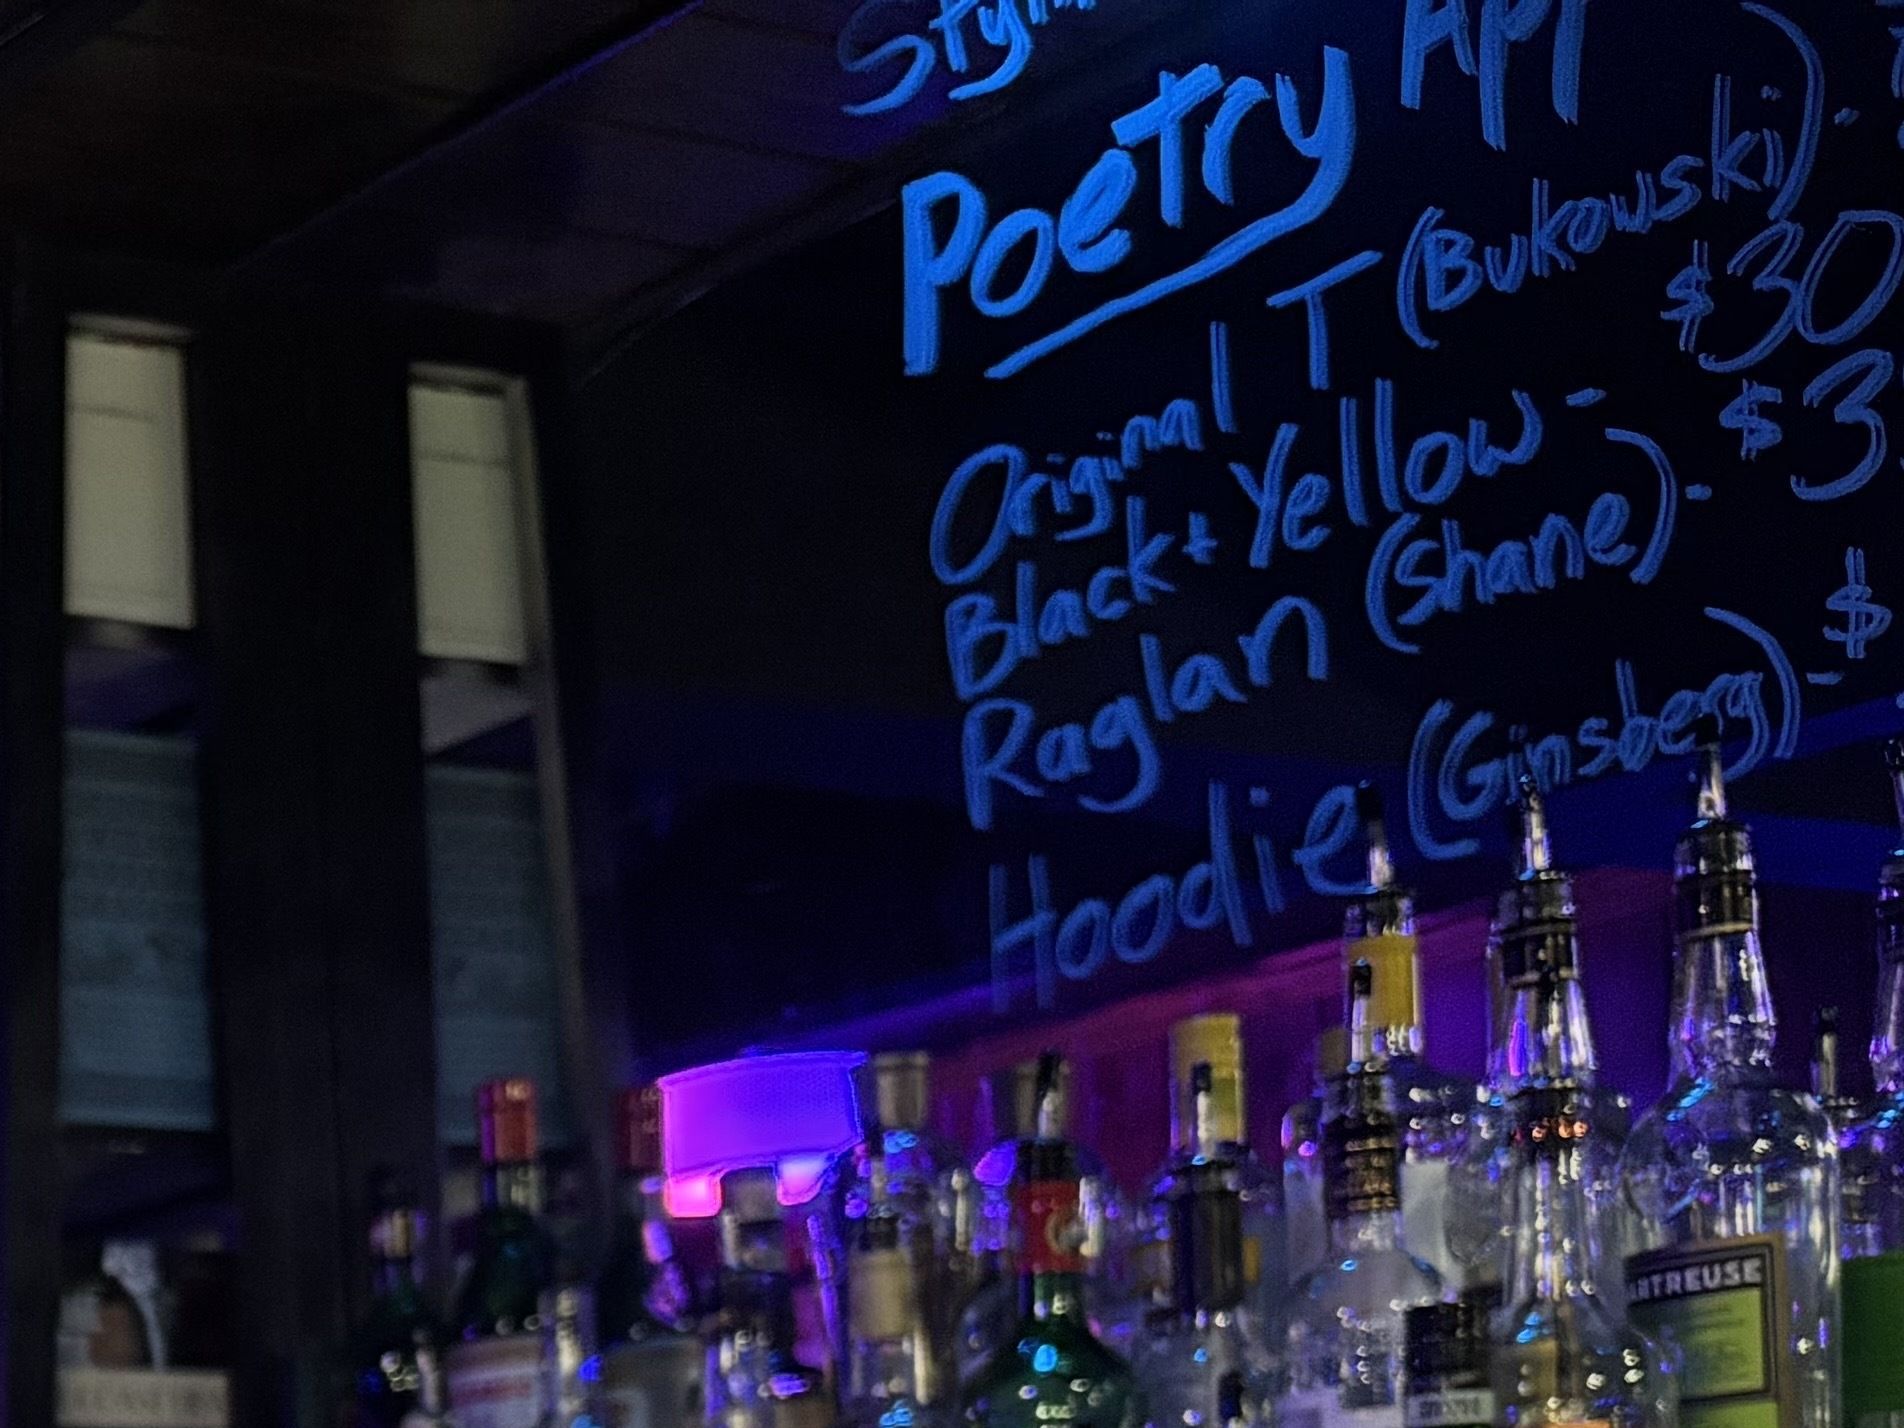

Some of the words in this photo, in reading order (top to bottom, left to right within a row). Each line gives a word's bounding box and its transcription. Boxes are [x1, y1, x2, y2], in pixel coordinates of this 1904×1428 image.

[902, 46, 1356, 377] Poetry
[929, 320, 1238, 585] Original
[1266, 250, 1384, 390] T
[1397, 2, 1825, 350] (Bukowski)
[944, 496, 1177, 701] Black
[1229, 375, 1543, 568] Yellow
[1659, 209, 1904, 373] $30
[960, 596, 1330, 832] Raglan
[1718, 346, 1904, 501] $3
[989, 777, 1378, 1014] Hoodie
